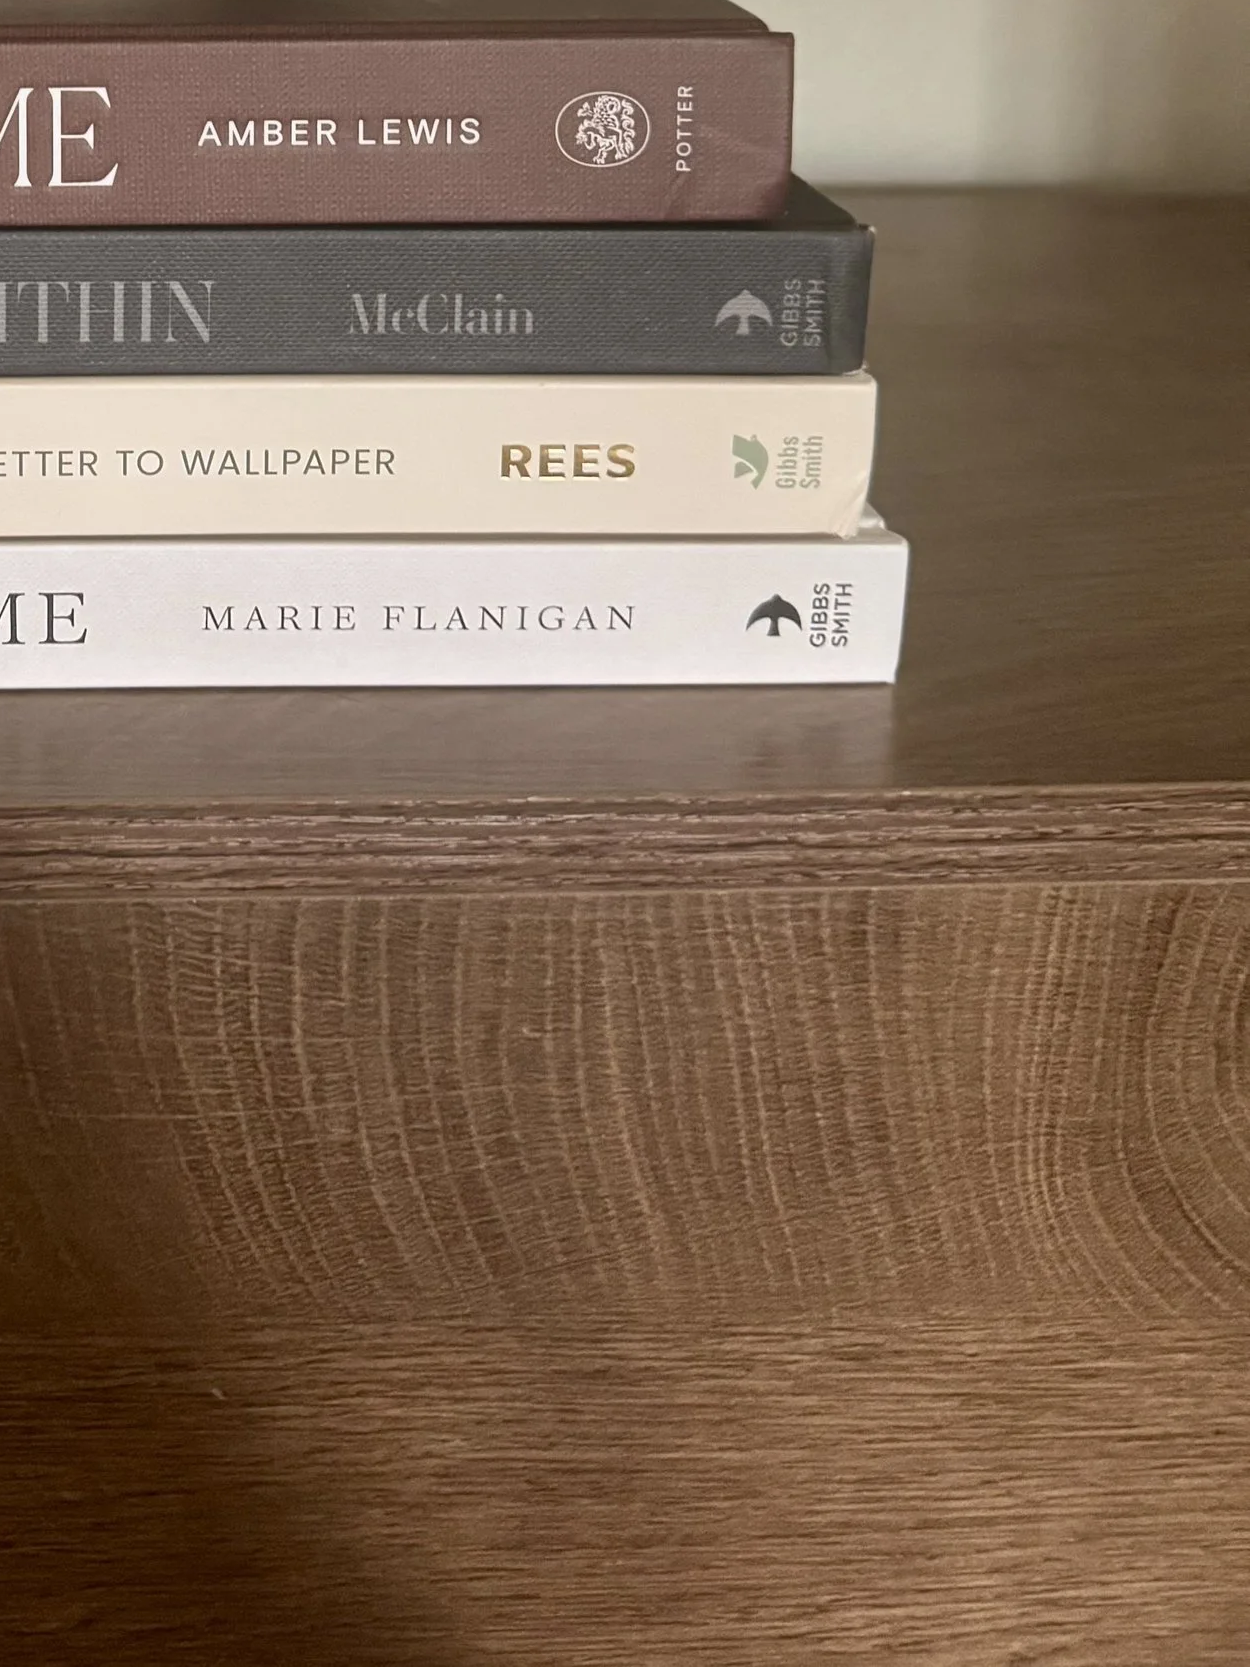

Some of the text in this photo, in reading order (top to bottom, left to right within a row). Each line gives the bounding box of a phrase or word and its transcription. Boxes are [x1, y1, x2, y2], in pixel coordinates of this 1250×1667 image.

[197, 117, 480, 147] AMBER LEWIS
[675, 85, 694, 173] POTTER
[351, 292, 534, 334] McClain
[779, 277, 803, 348] GIBBS
[804, 277, 826, 348] SMITH
[115, 449, 164, 477] TO
[180, 448, 395, 476] WALLPAPER
[500, 444, 636, 479] REES
[774, 436, 799, 490] Gibbs
[798, 435, 823, 490] Smith
[201, 604, 637, 632] MARIE FLANIGAN
[809, 582, 831, 648] GIBBS
[831, 583, 853, 647] SMITH
